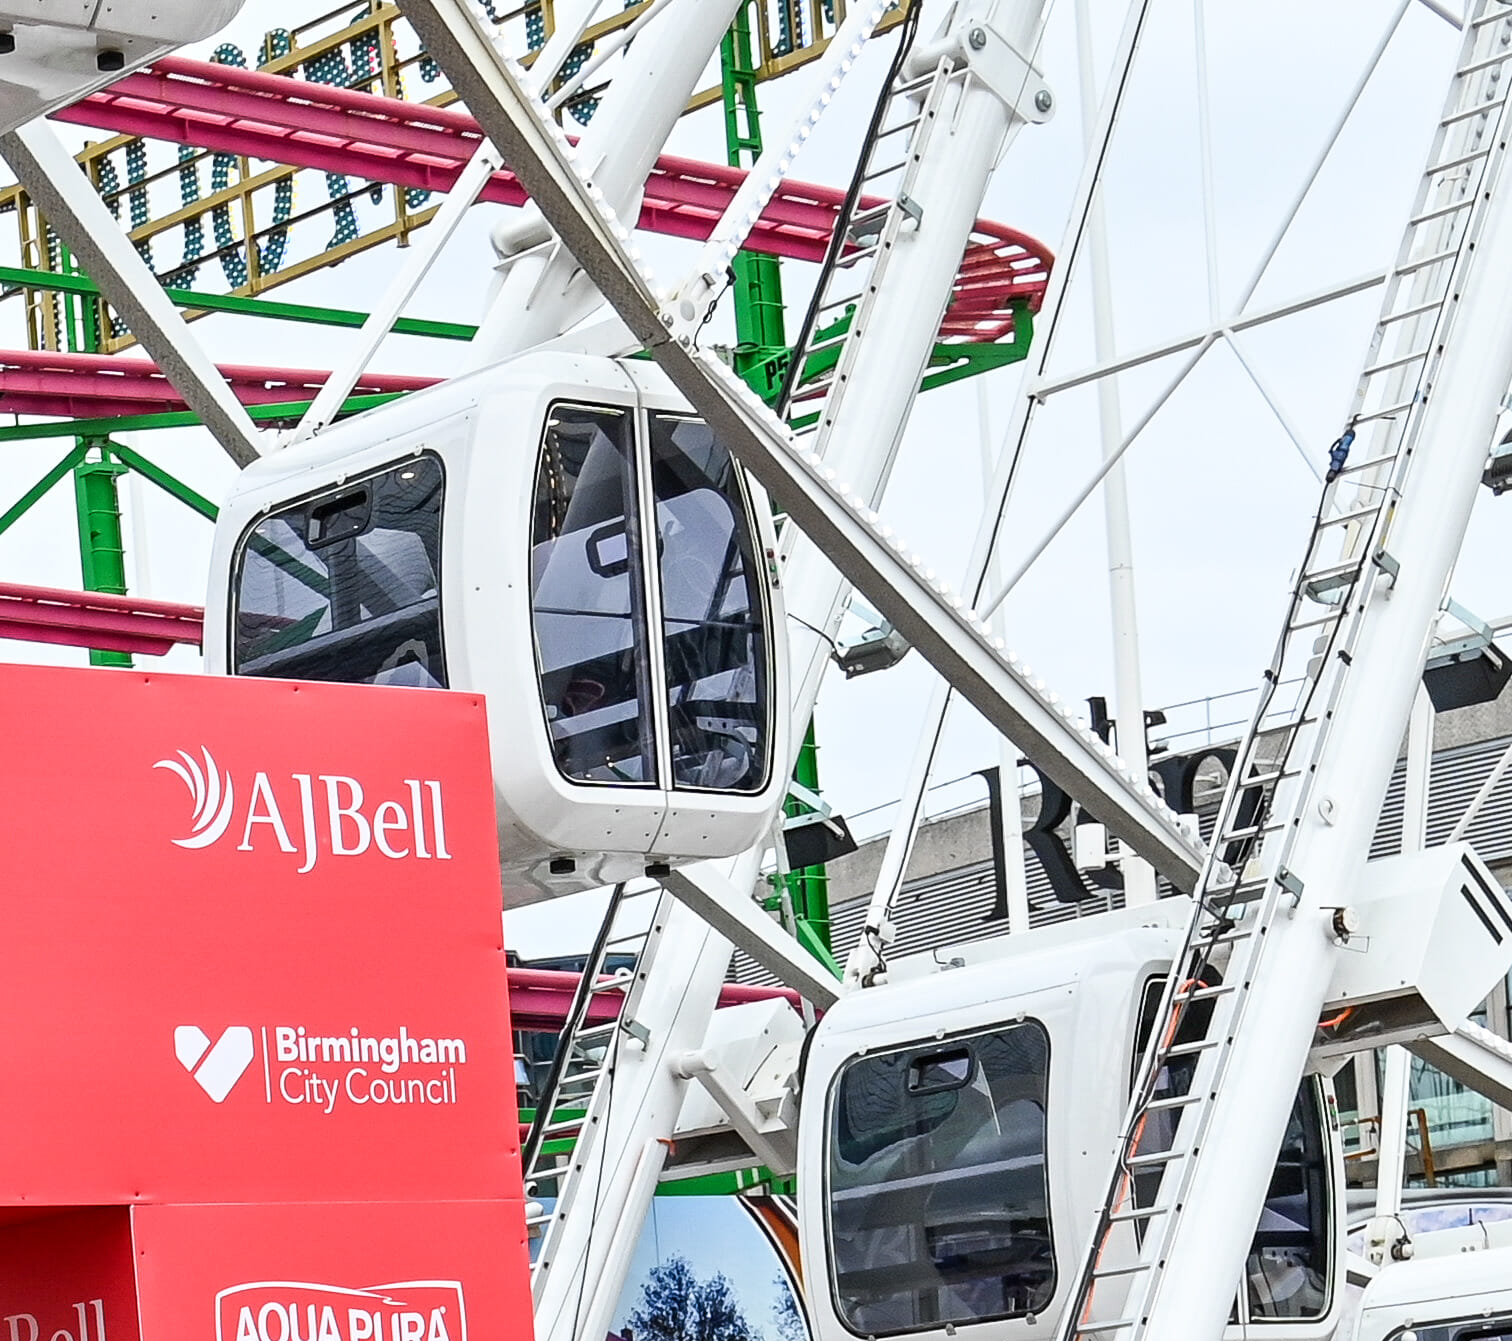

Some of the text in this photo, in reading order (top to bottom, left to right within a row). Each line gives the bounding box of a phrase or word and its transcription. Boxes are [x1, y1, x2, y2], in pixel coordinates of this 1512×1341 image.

[238, 772, 451, 873] AJBell
[275, 1026, 467, 1074] Birmingham
[280, 1066, 456, 1114] City Council
